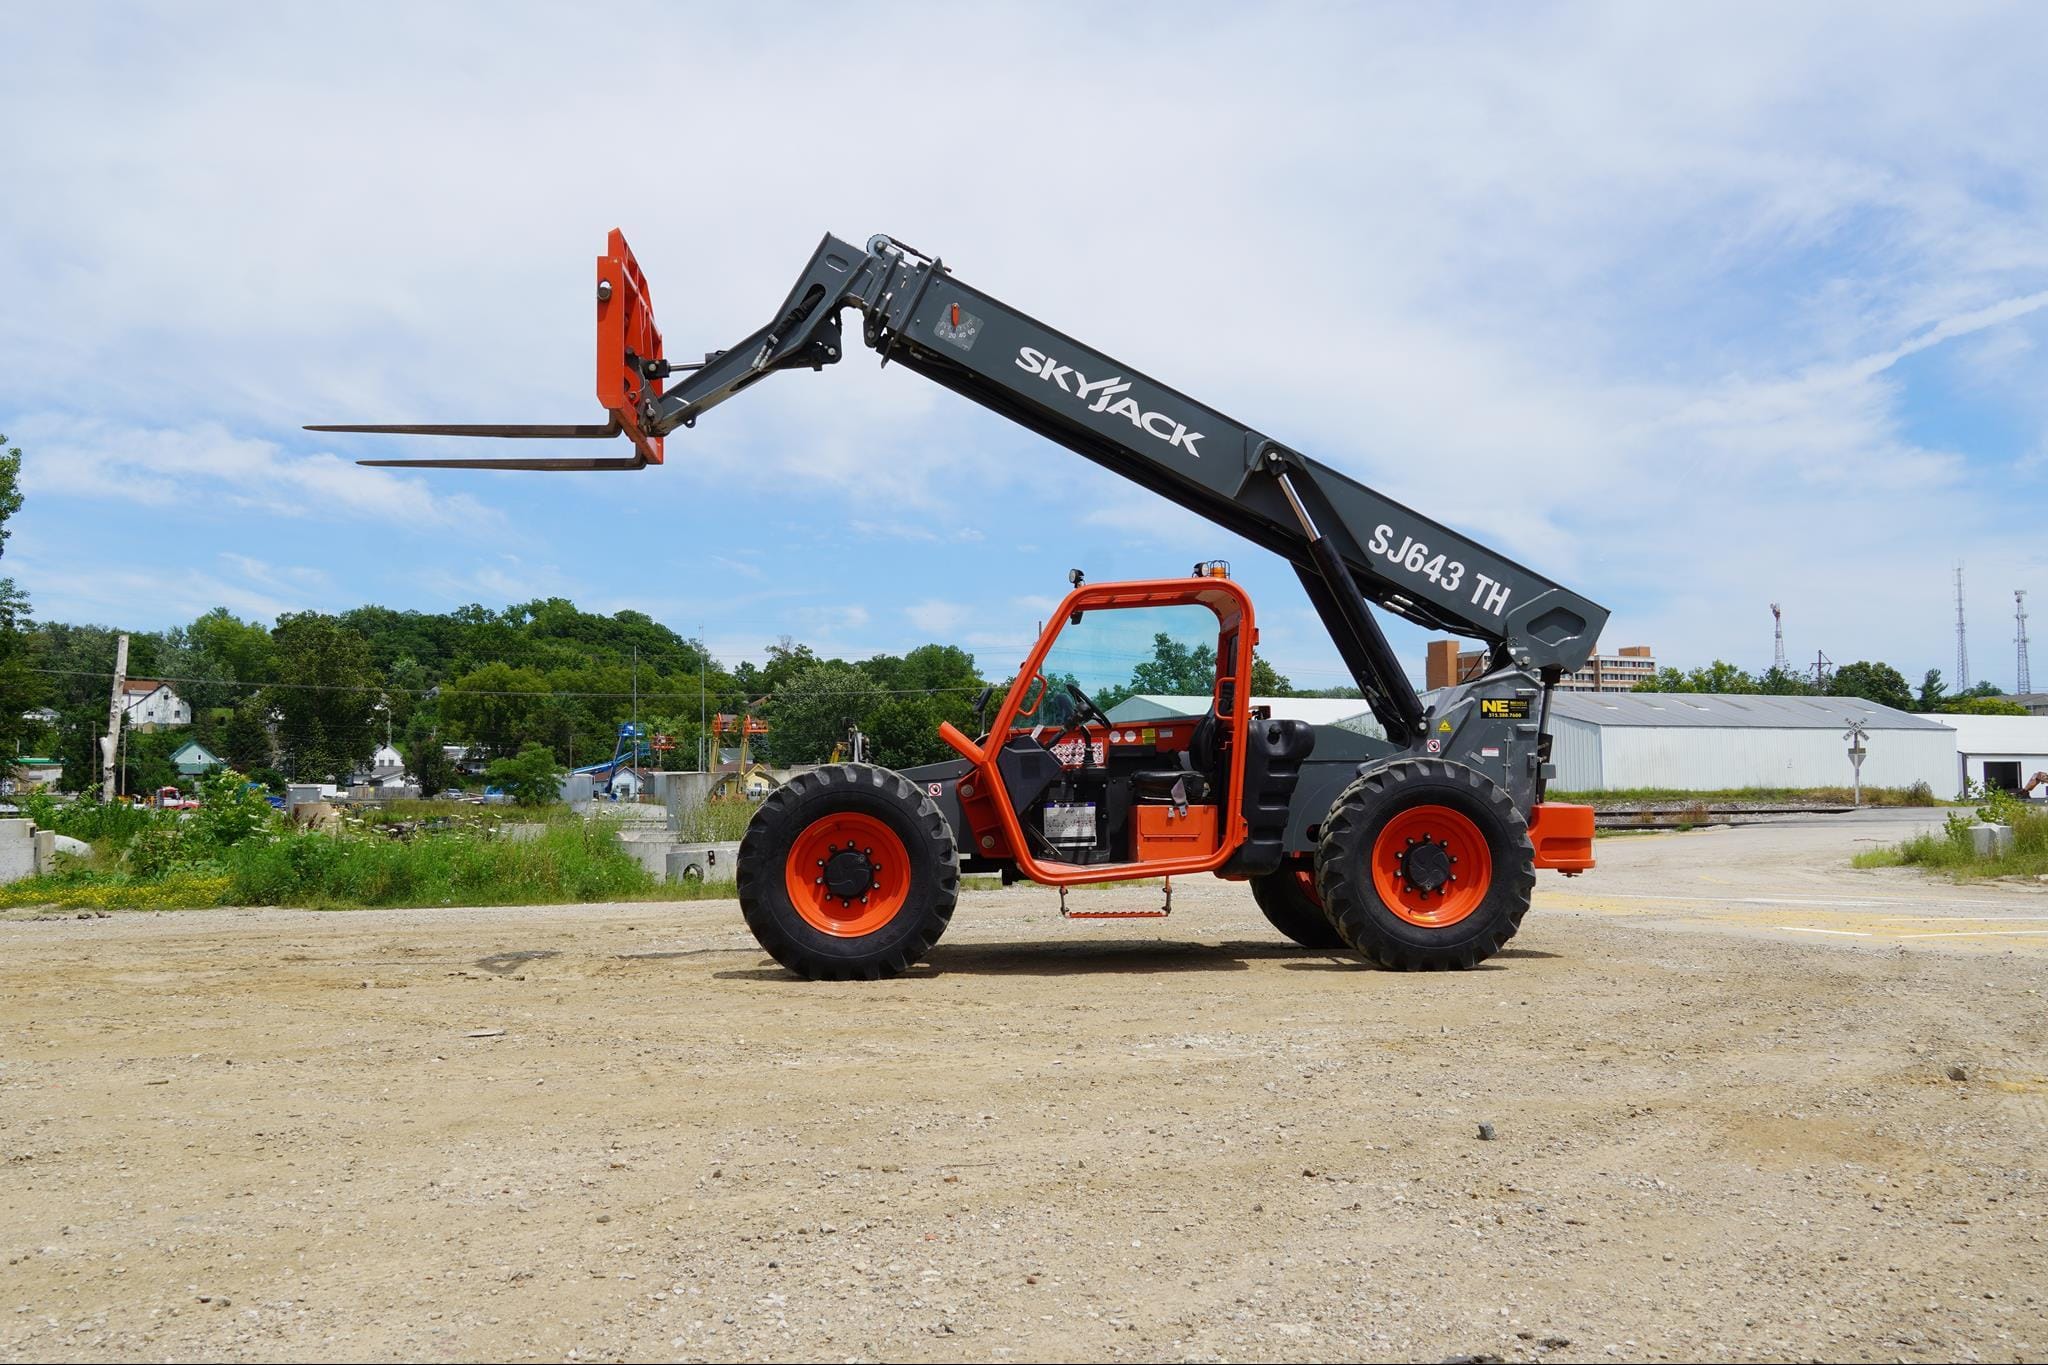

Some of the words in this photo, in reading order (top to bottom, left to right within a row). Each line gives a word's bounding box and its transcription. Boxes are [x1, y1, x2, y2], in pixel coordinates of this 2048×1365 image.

[1015, 346, 1205, 458] SKYJACK
[1368, 524, 1465, 592] SJ643
[1470, 573, 1512, 617] TH
[1482, 700, 1509, 713] NE
